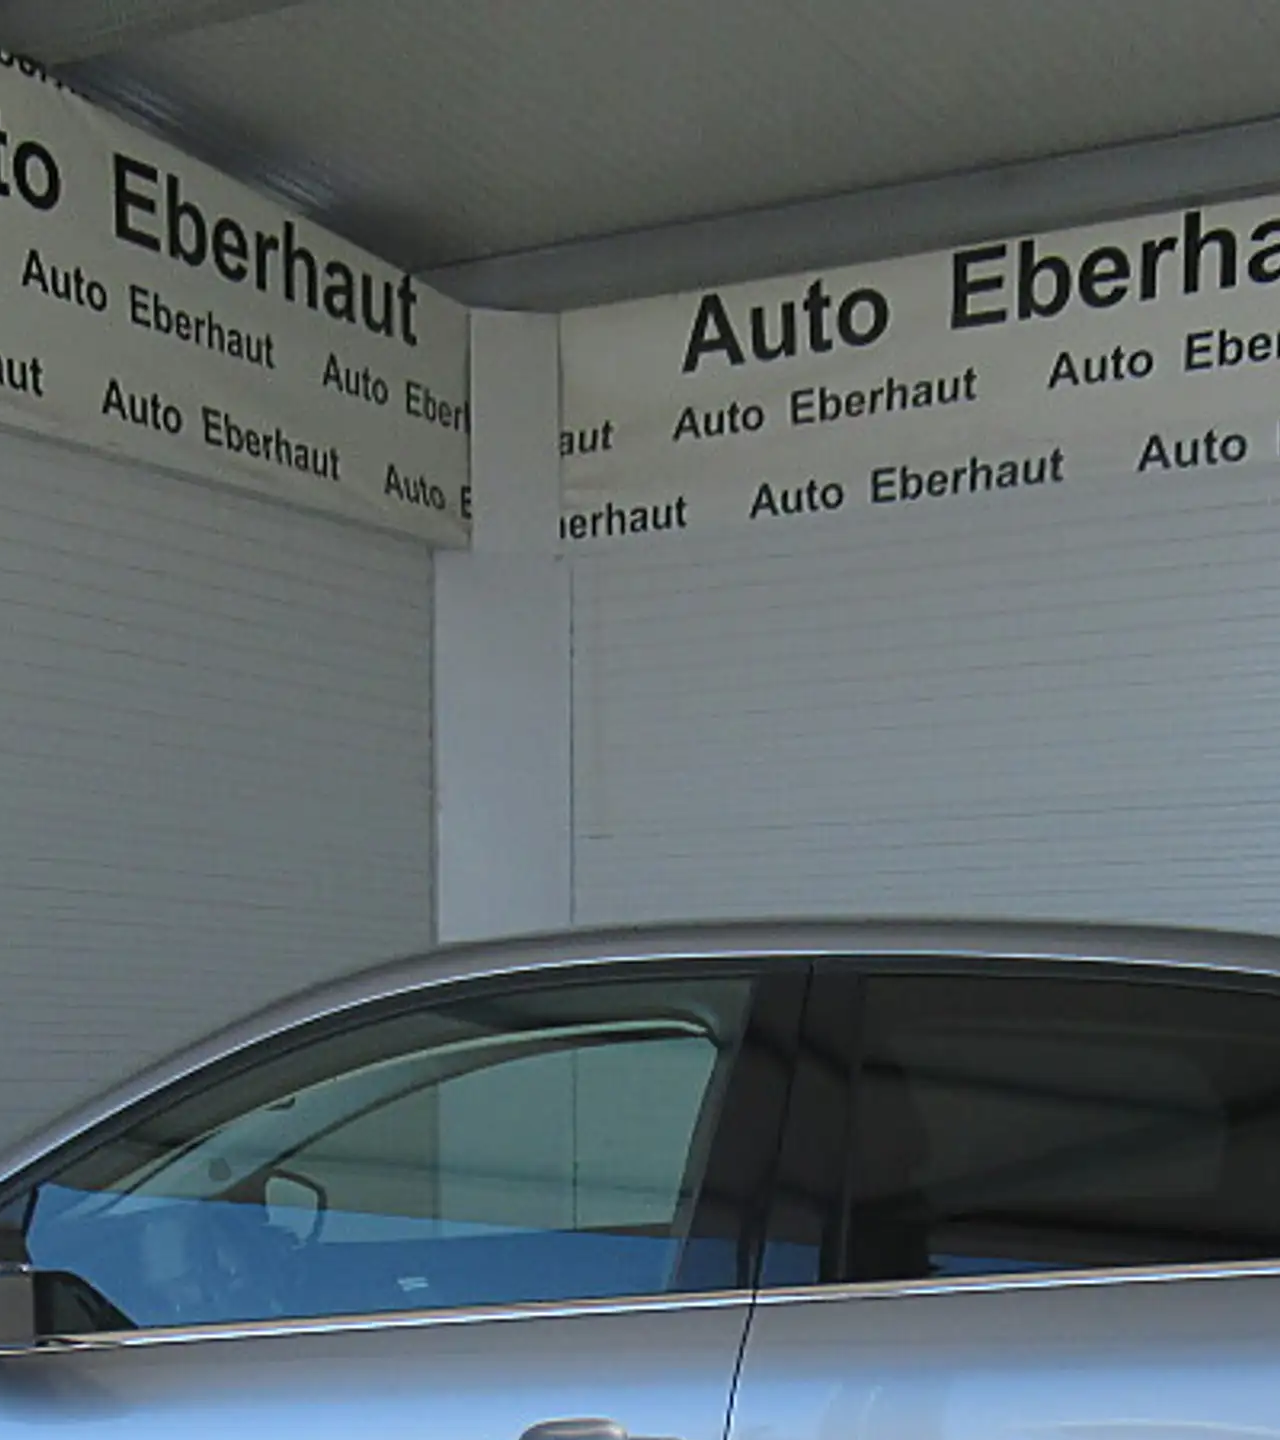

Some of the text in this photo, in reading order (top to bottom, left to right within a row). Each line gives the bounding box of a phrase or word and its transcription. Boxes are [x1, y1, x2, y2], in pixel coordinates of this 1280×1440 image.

[113, 152, 419, 347] Eberhaut
[22, 248, 276, 370] Auto Eberhaut
[682, 279, 889, 374] Auto
[322, 352, 389, 405] Auto
[1048, 345, 1153, 389] Auto
[102, 378, 339, 481] Auto Eberhaut
[672, 367, 977, 442] Auto Eberhaut
[384, 463, 446, 511] Auto
[749, 447, 1064, 519] Auto Eberhaut
[1138, 429, 1248, 472] Auto
